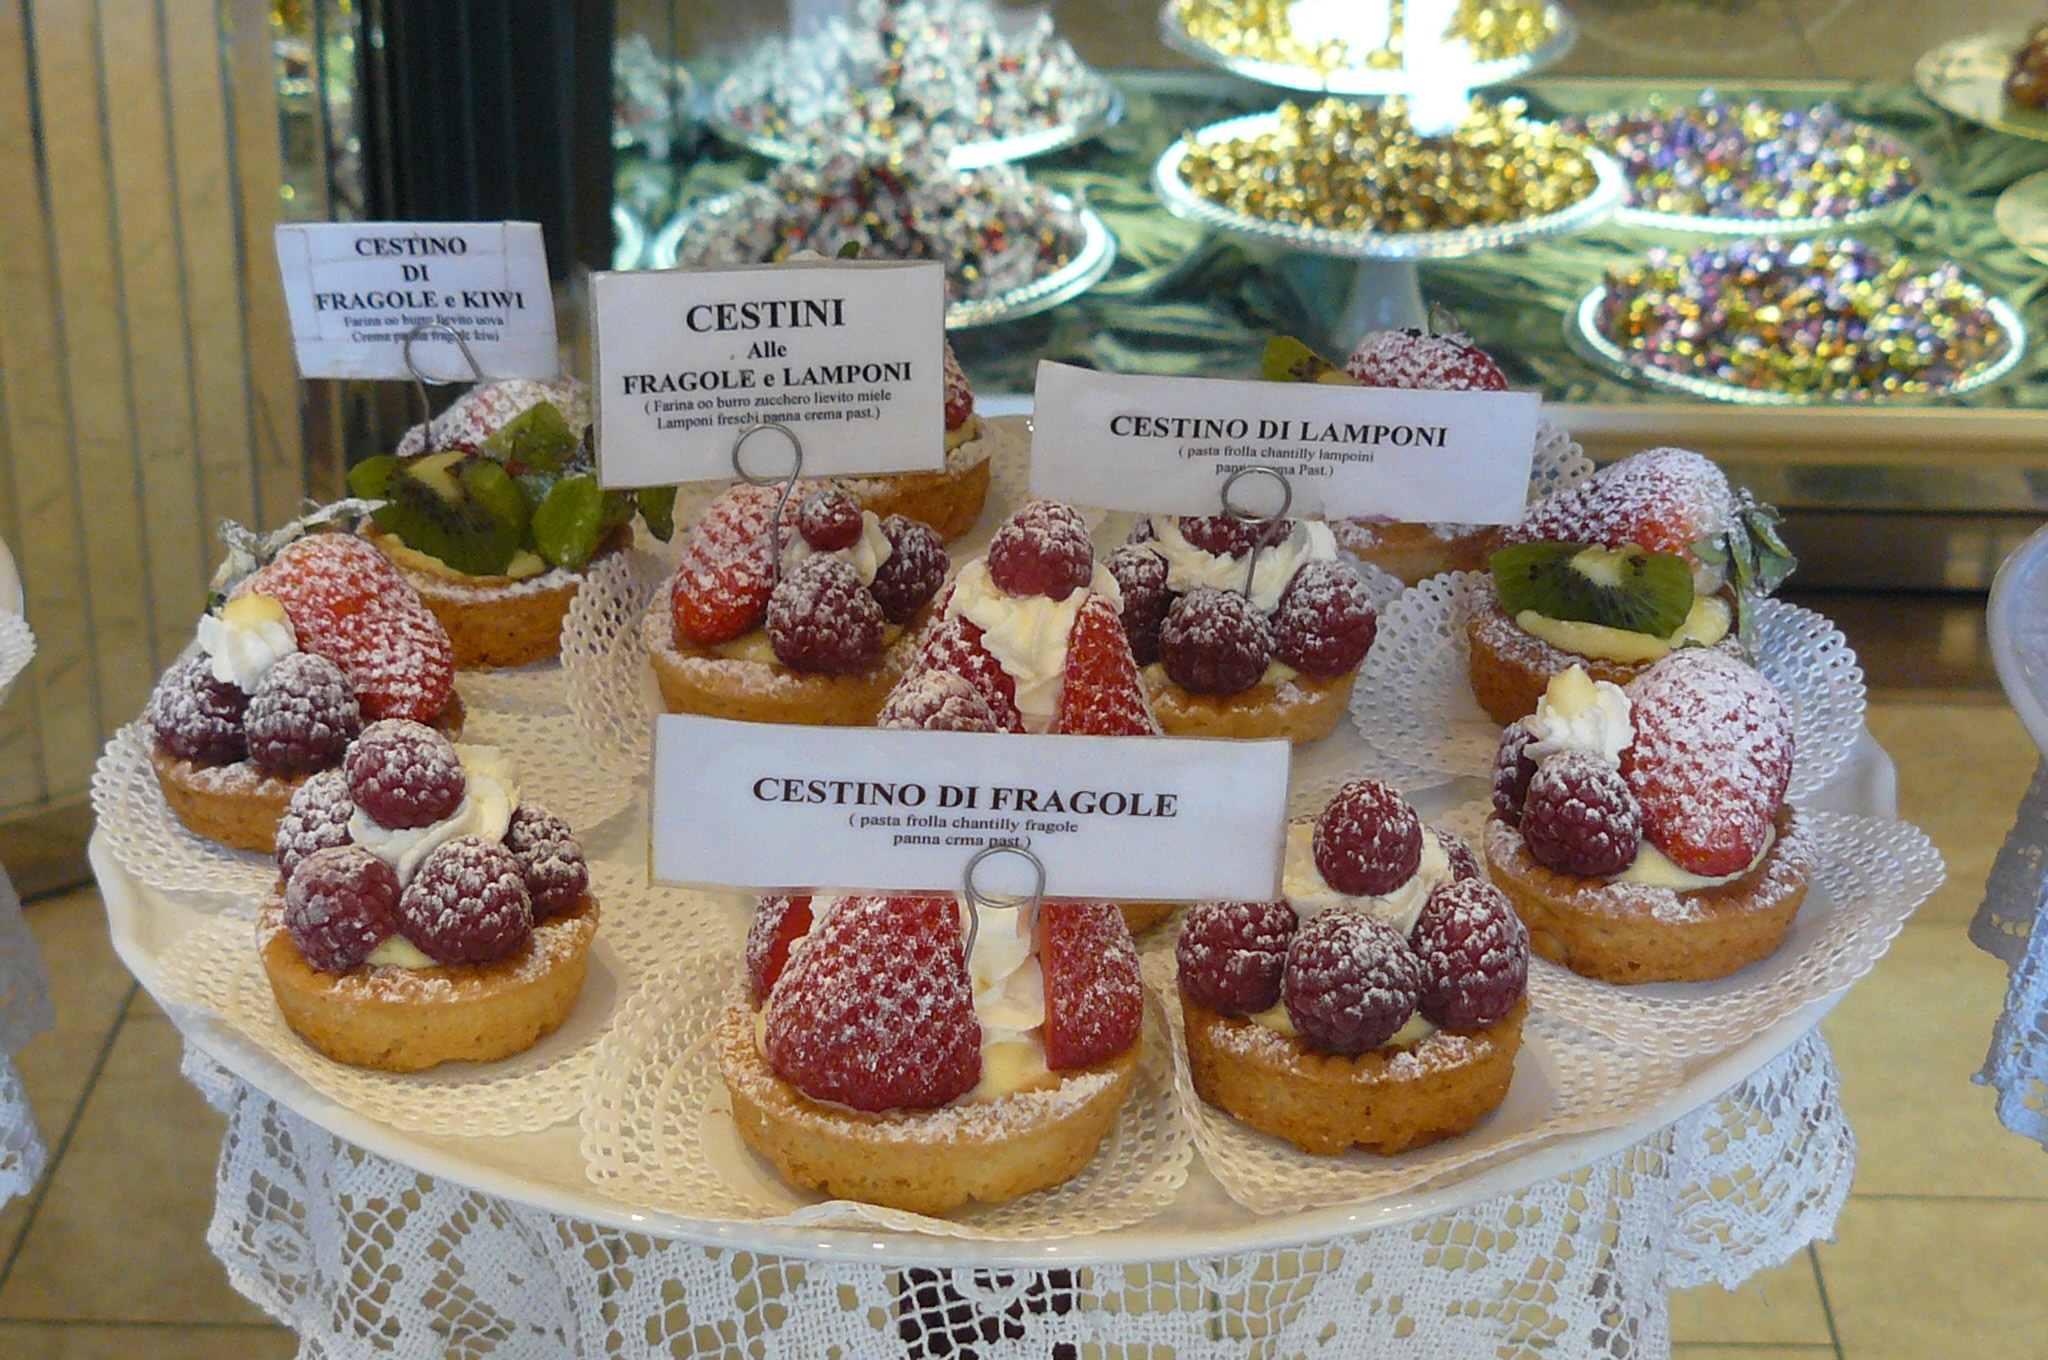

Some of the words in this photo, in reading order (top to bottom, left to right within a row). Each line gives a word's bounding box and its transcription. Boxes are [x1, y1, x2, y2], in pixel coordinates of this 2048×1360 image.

[355, 237, 468, 257] CESTINO
[402, 263, 430, 283] DI
[315, 290, 439, 311] FRAGOLE
[445, 296, 456, 308] e
[463, 291, 527, 310] KIWI
[686, 298, 846, 333] CESTINI
[747, 341, 787, 360] Alle
[622, 368, 756, 397] FRAGOLE
[763, 373, 776, 388] e
[783, 361, 912, 388] LAMPONI
[654, 399, 695, 413] Farina
[717, 396, 751, 409] burro
[754, 393, 811, 407] zucchero
[814, 390, 854, 405] lievito
[857, 389, 892, 403] miele
[658, 415, 713, 430] Lamponi
[717, 412, 760, 426] freschi
[763, 411, 801, 425] panna
[804, 409, 843, 422] crema
[1110, 415, 1249, 440] CESTINO
[1257, 419, 1292, 441] DI
[1299, 420, 1448, 448] LAMPONI
[1187, 446, 1221, 459] pasta
[1223, 444, 1257, 458] frolla
[1260, 445, 1316, 461] chantilly
[1318, 447, 1375, 465] lampoini
[753, 777, 926, 809] CESTINO
[938, 785, 981, 810] DI
[990, 786, 1179, 819] FRAGOLE
[860, 814, 901, 829] pasta
[906, 813, 948, 828] frolla
[952, 816, 1020, 833] chantilly
[1025, 818, 1079, 835] fragole
[893, 833, 941, 847] panna
[945, 835, 985, 847] crma
